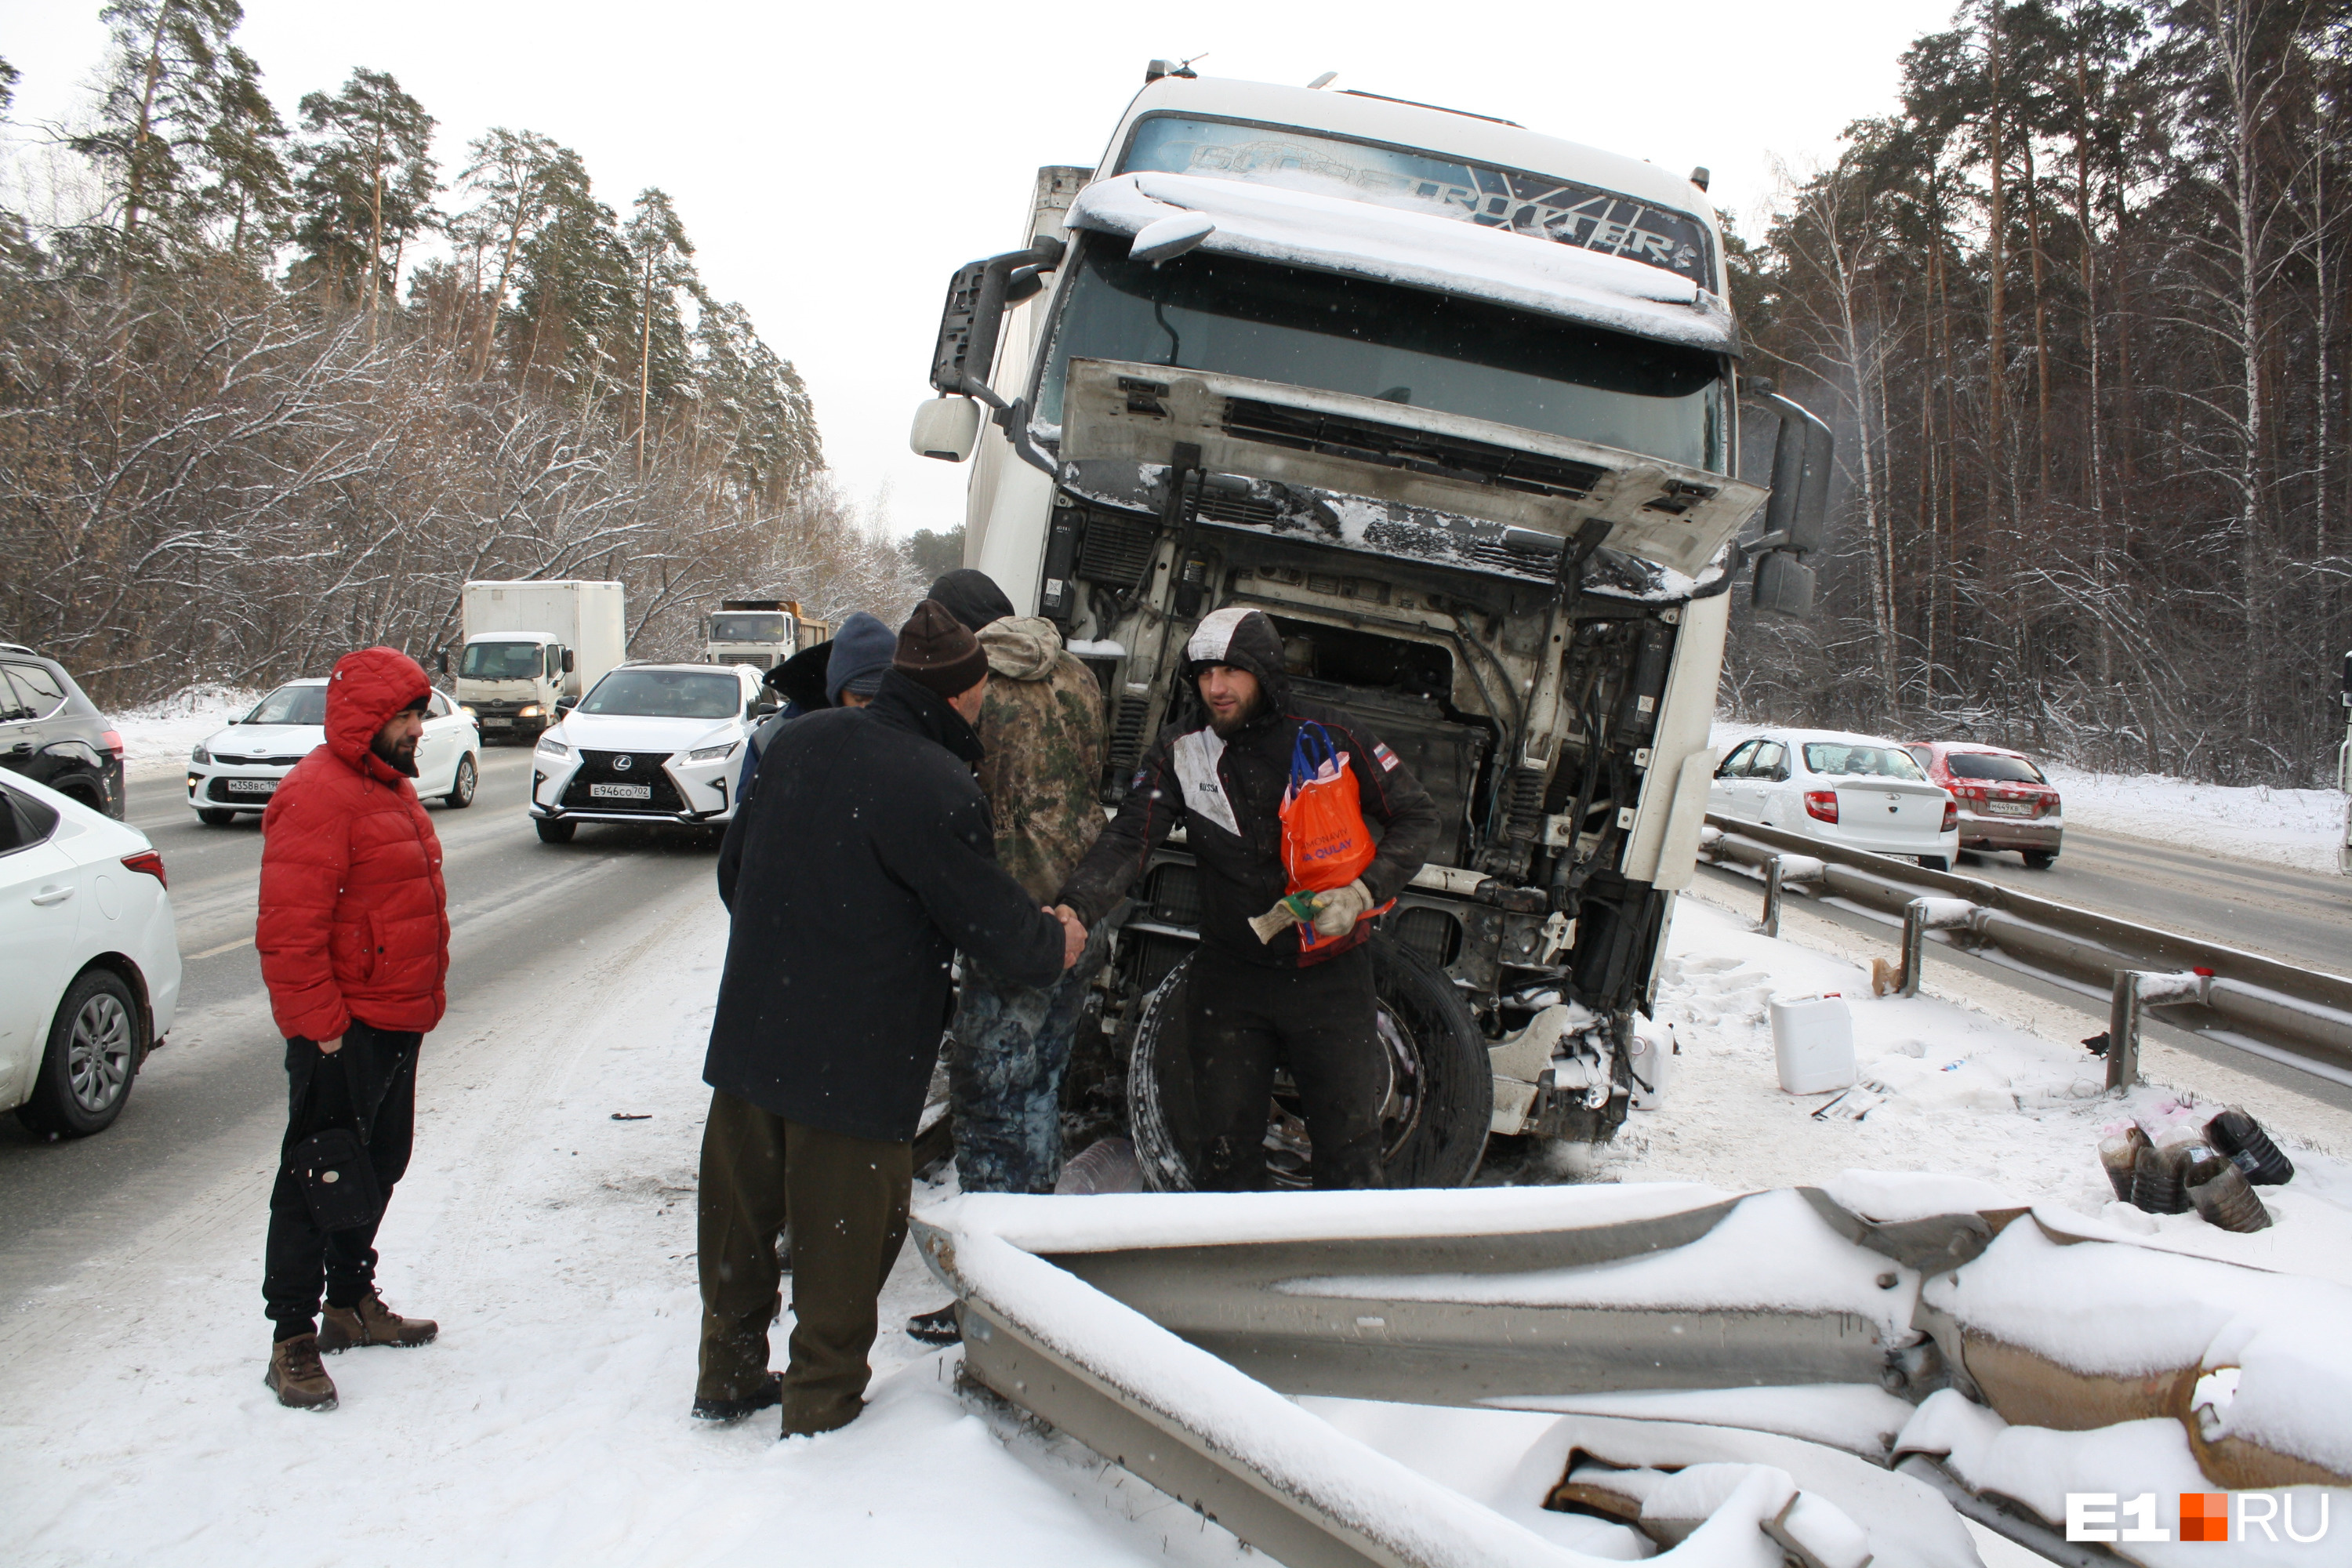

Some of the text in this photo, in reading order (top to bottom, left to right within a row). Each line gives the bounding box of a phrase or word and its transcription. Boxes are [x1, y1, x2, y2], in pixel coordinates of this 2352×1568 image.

[593, 786, 648, 797] Е946СО 702
[1316, 838, 1352, 859] QULAY
